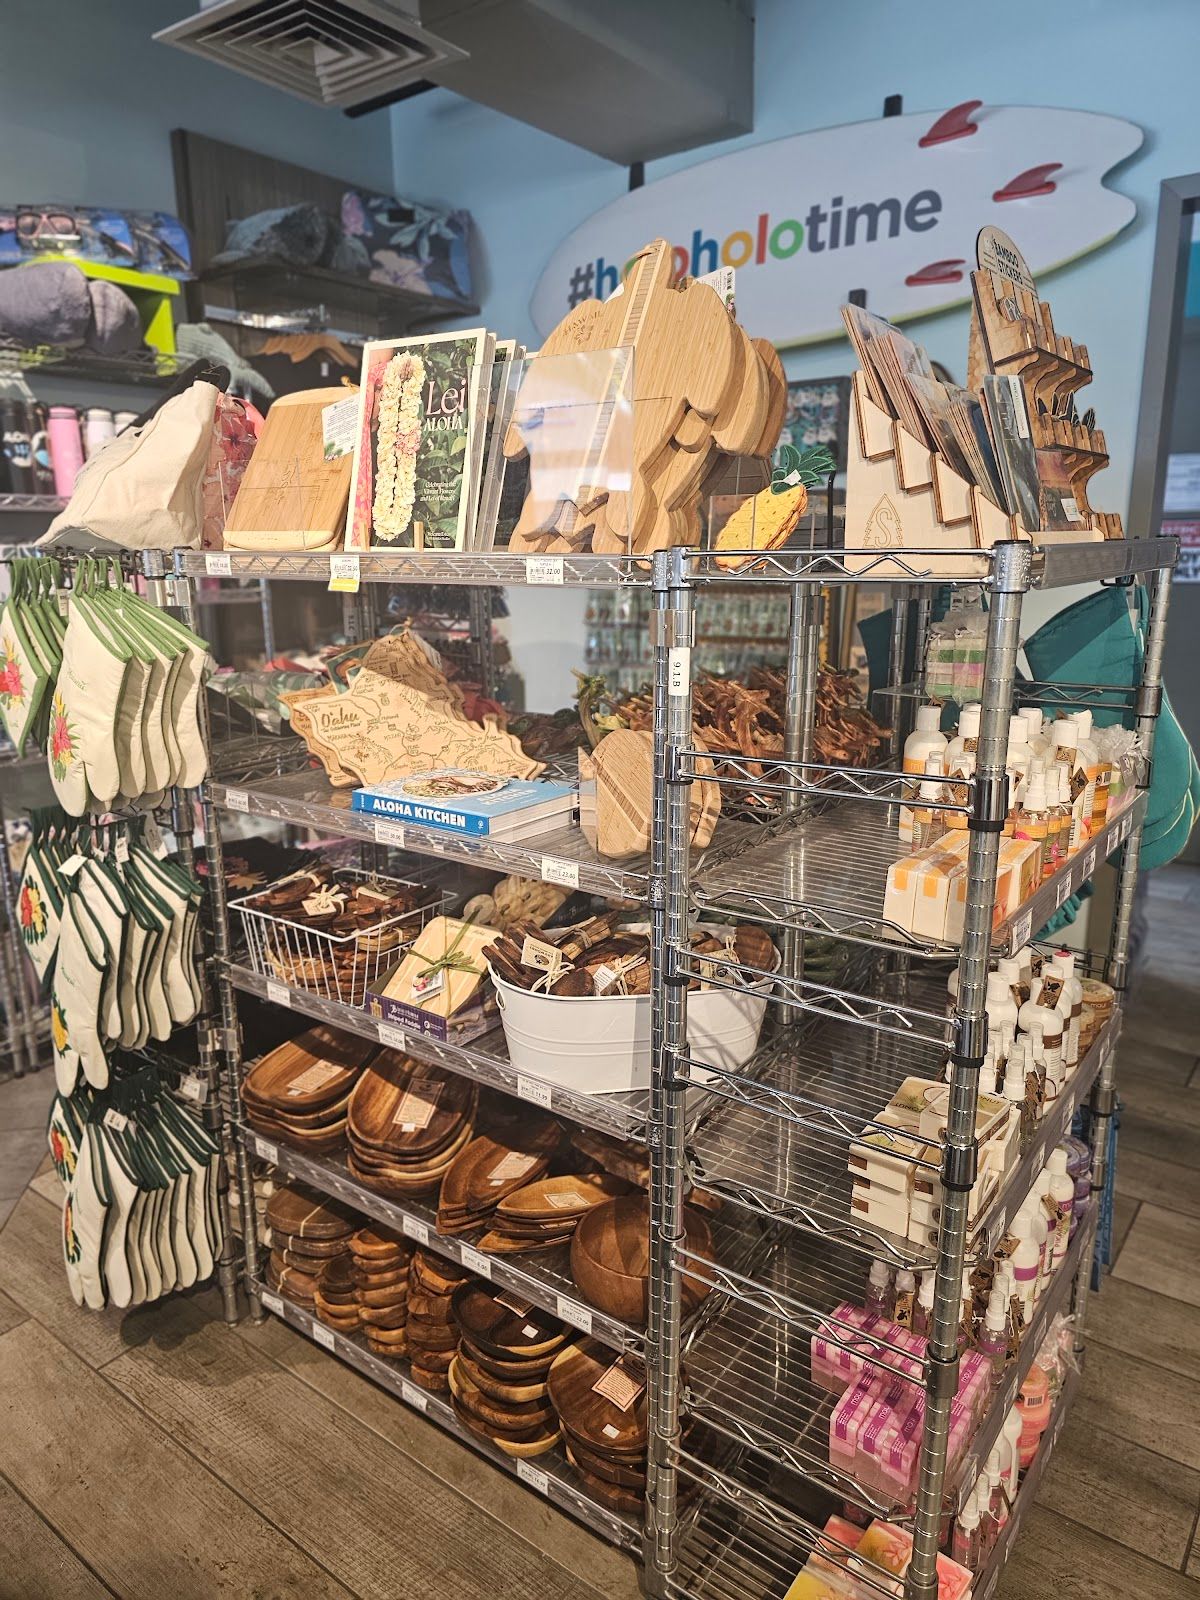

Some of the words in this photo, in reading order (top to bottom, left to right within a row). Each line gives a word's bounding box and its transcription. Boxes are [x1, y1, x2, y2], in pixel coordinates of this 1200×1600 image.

[426, 378, 467, 415] Lei
[423, 415, 463, 431] ALOHA
[373, 798, 413, 817] ALOHA
[414, 805, 467, 828] KITCHEN
